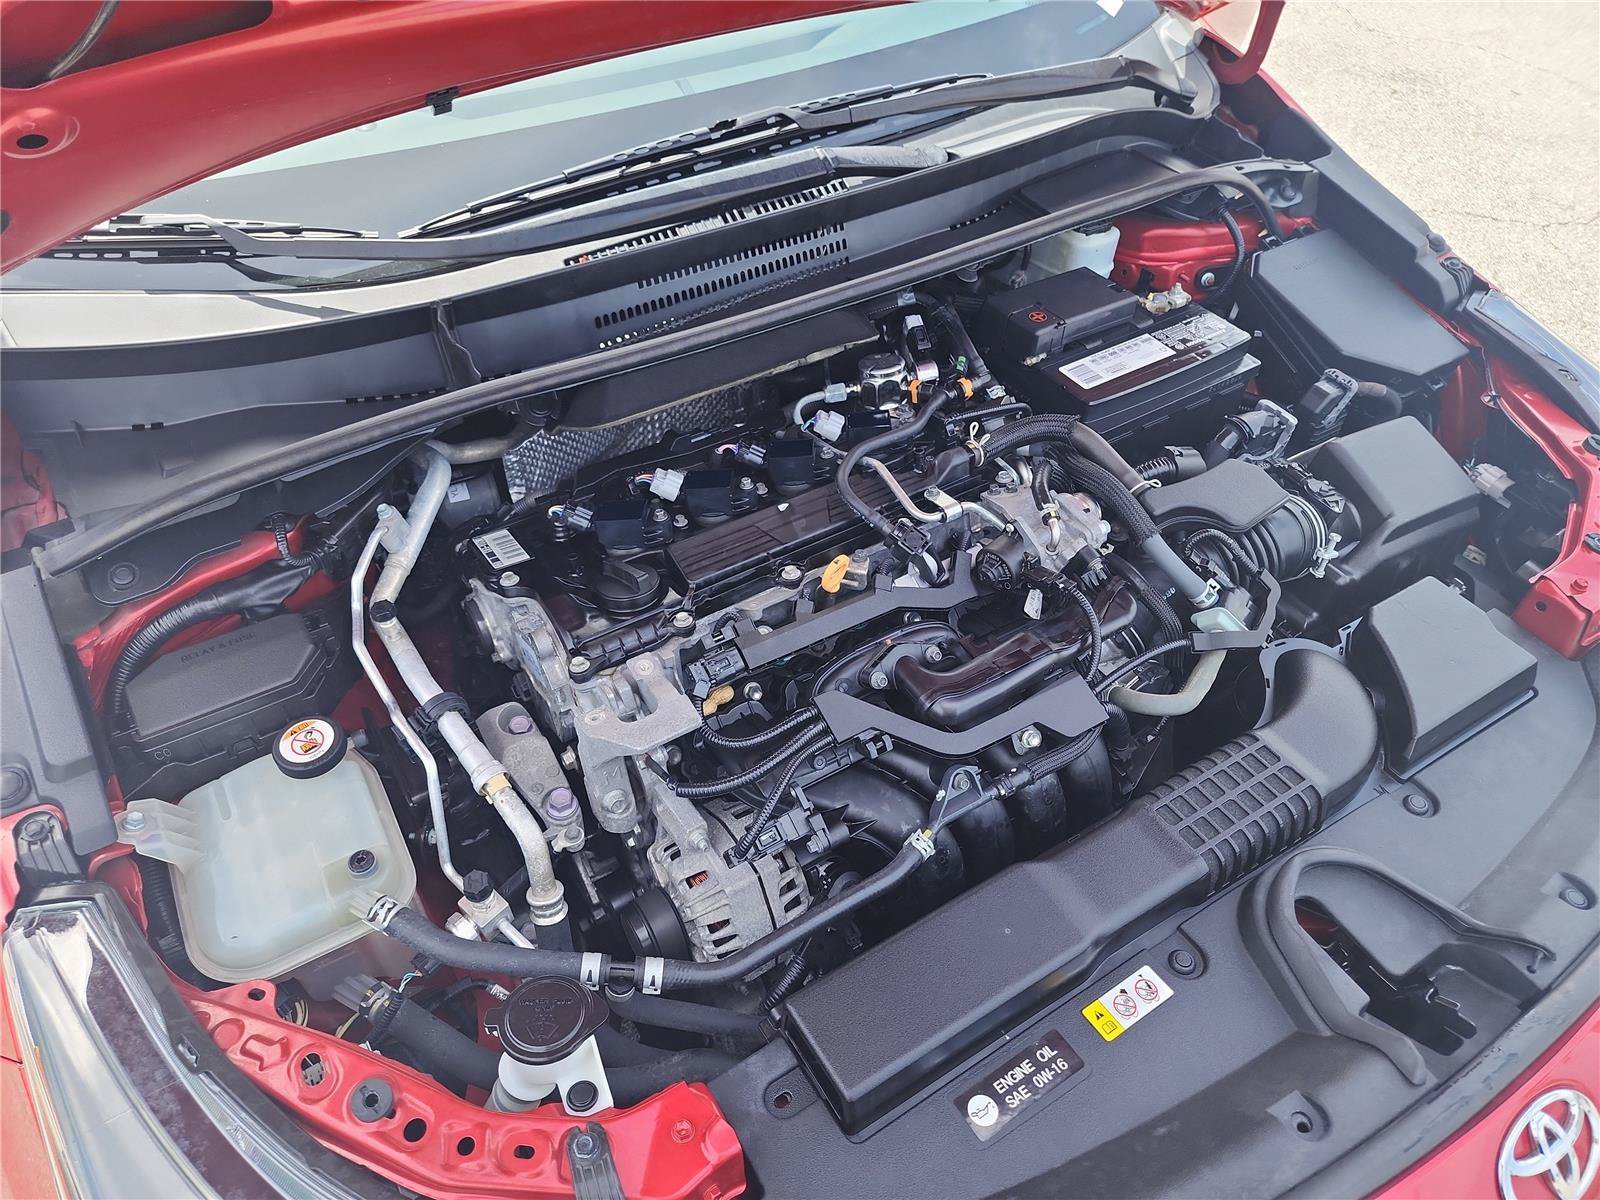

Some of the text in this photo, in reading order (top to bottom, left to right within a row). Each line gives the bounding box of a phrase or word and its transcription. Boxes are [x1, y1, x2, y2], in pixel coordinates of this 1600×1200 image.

[993, 1045, 1058, 1094] ENGINE OIL
[1005, 1058, 1069, 1108] SAE 0W-16
